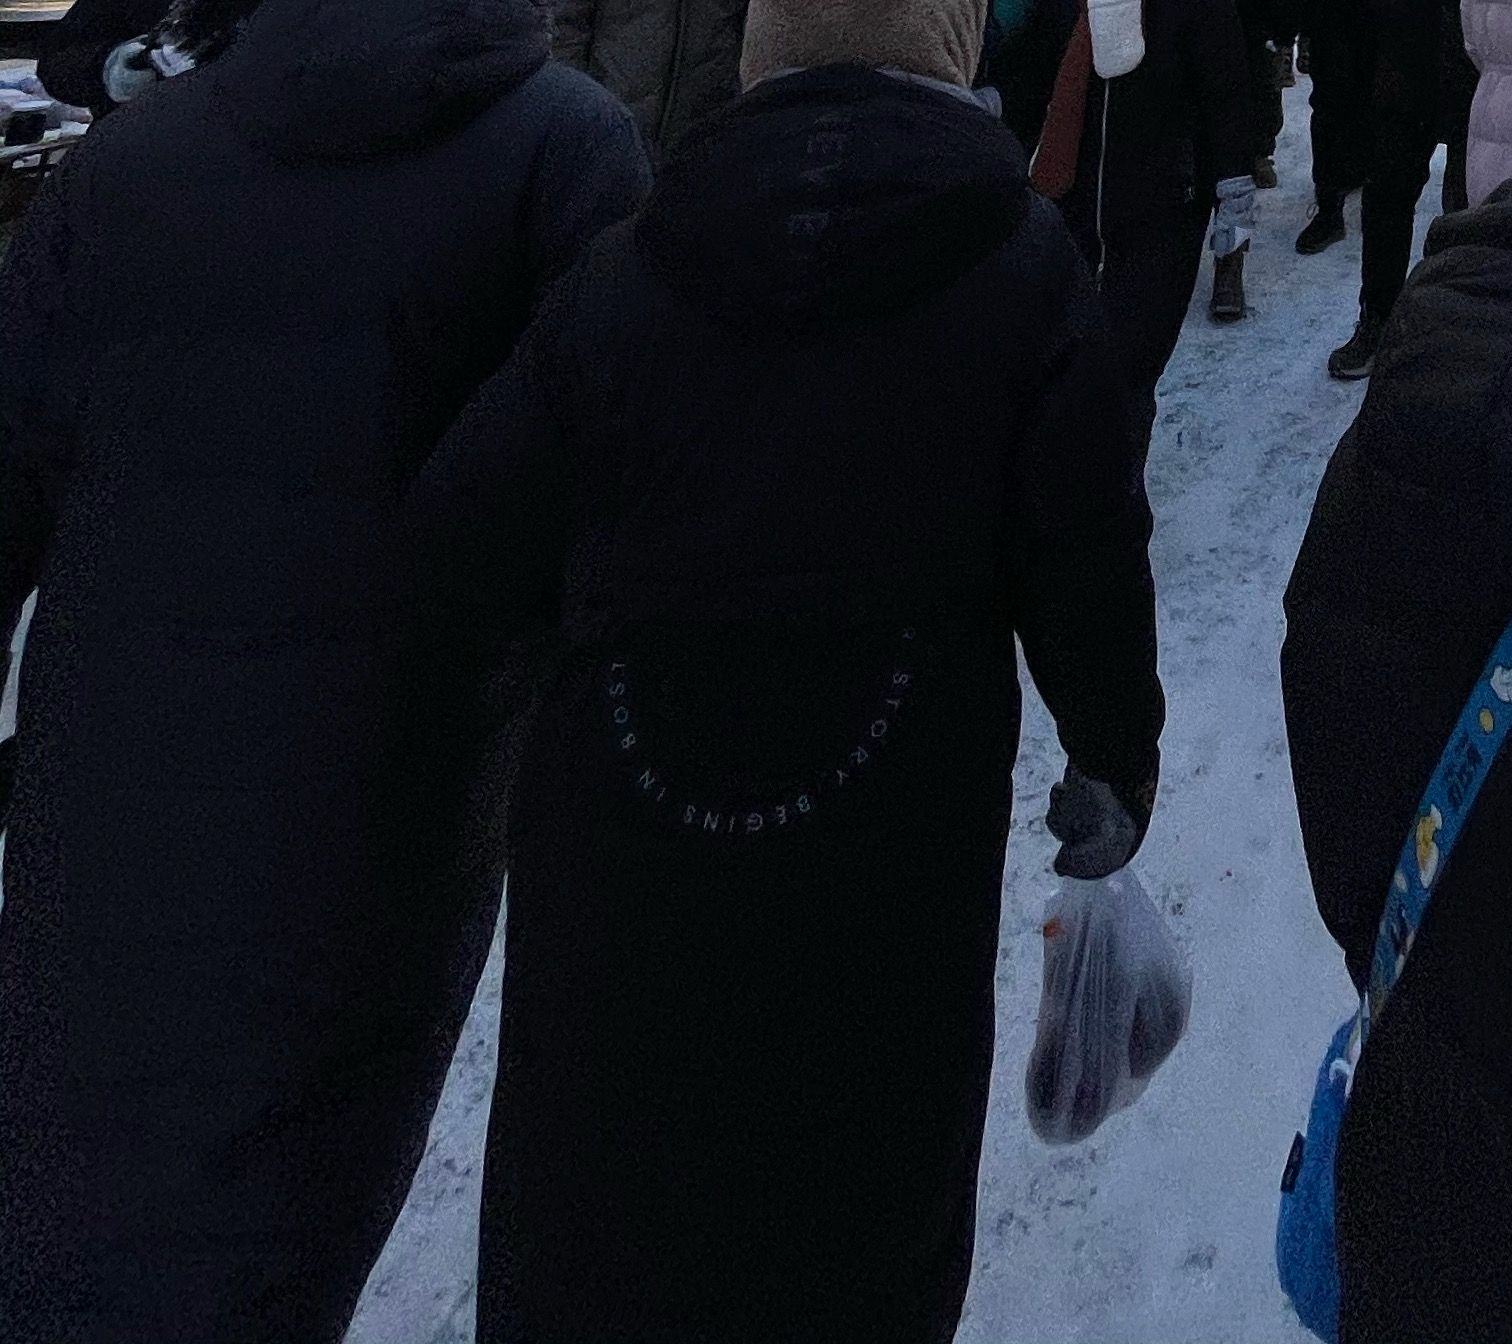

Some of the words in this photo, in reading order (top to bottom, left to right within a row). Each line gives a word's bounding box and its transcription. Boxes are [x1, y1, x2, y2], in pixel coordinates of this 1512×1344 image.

[834, 671, 911, 789] STORY
[638, 767, 668, 803] IN
[682, 792, 812, 834] BEGINS
